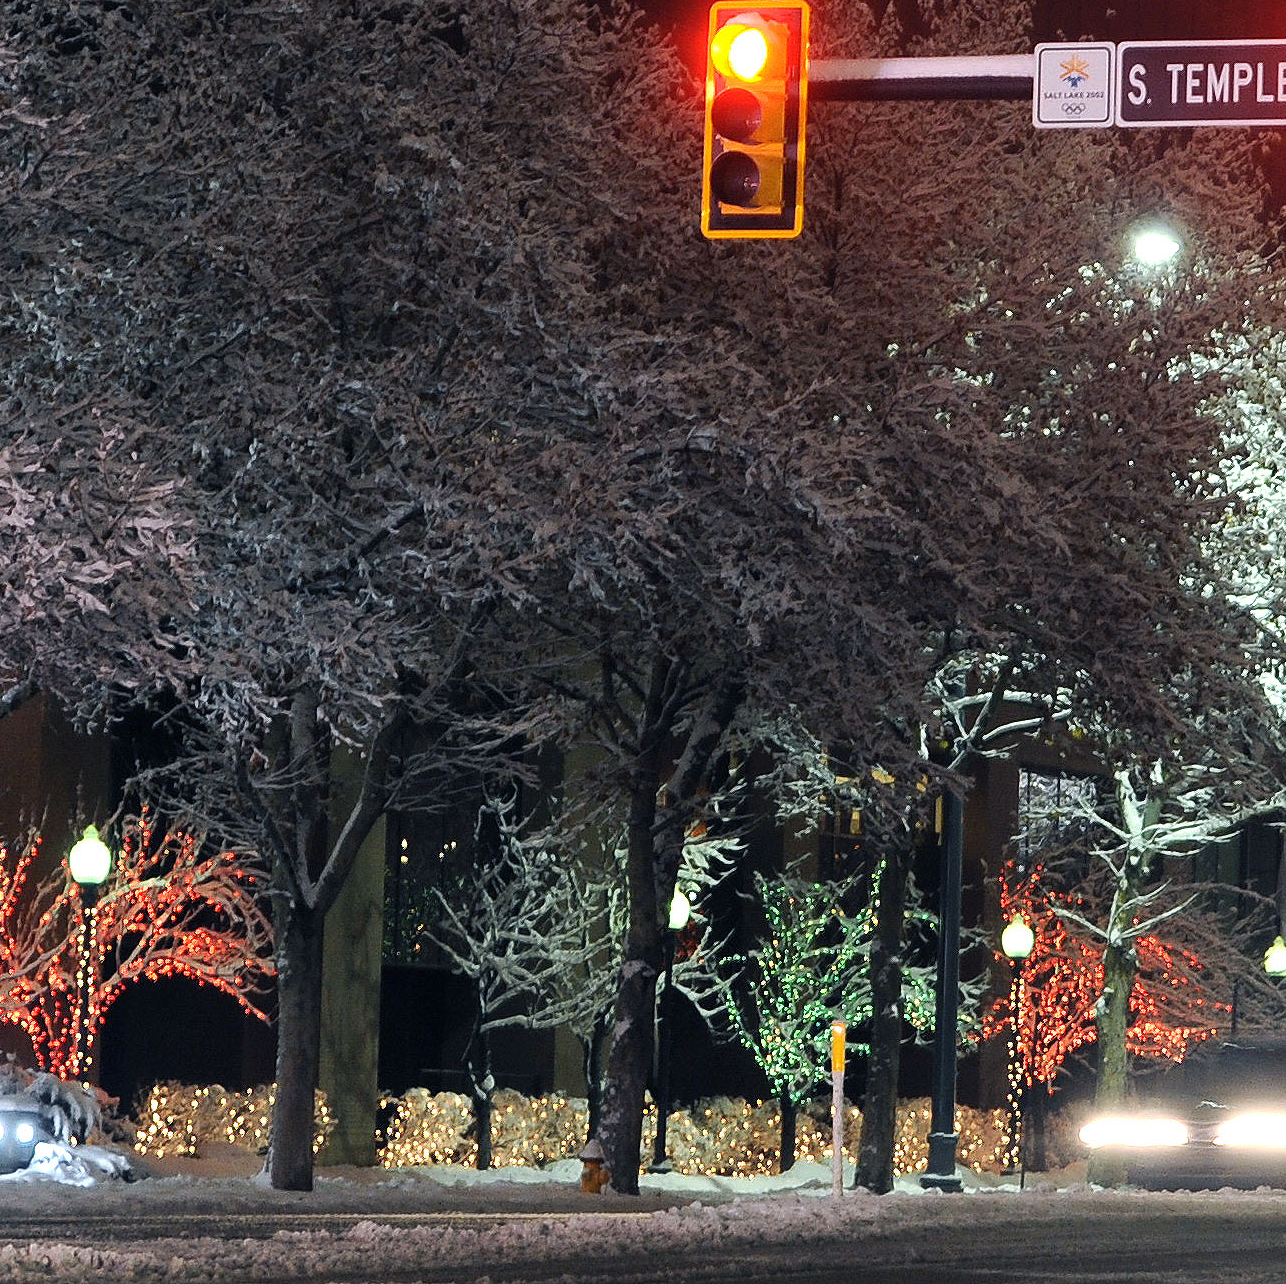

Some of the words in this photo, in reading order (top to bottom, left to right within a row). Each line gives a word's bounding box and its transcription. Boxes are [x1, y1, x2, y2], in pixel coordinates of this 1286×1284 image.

[1044, 91, 1062, 99] SALT
[1064, 91, 1084, 99] LAKE
[1128, 63, 1153, 105] S.
